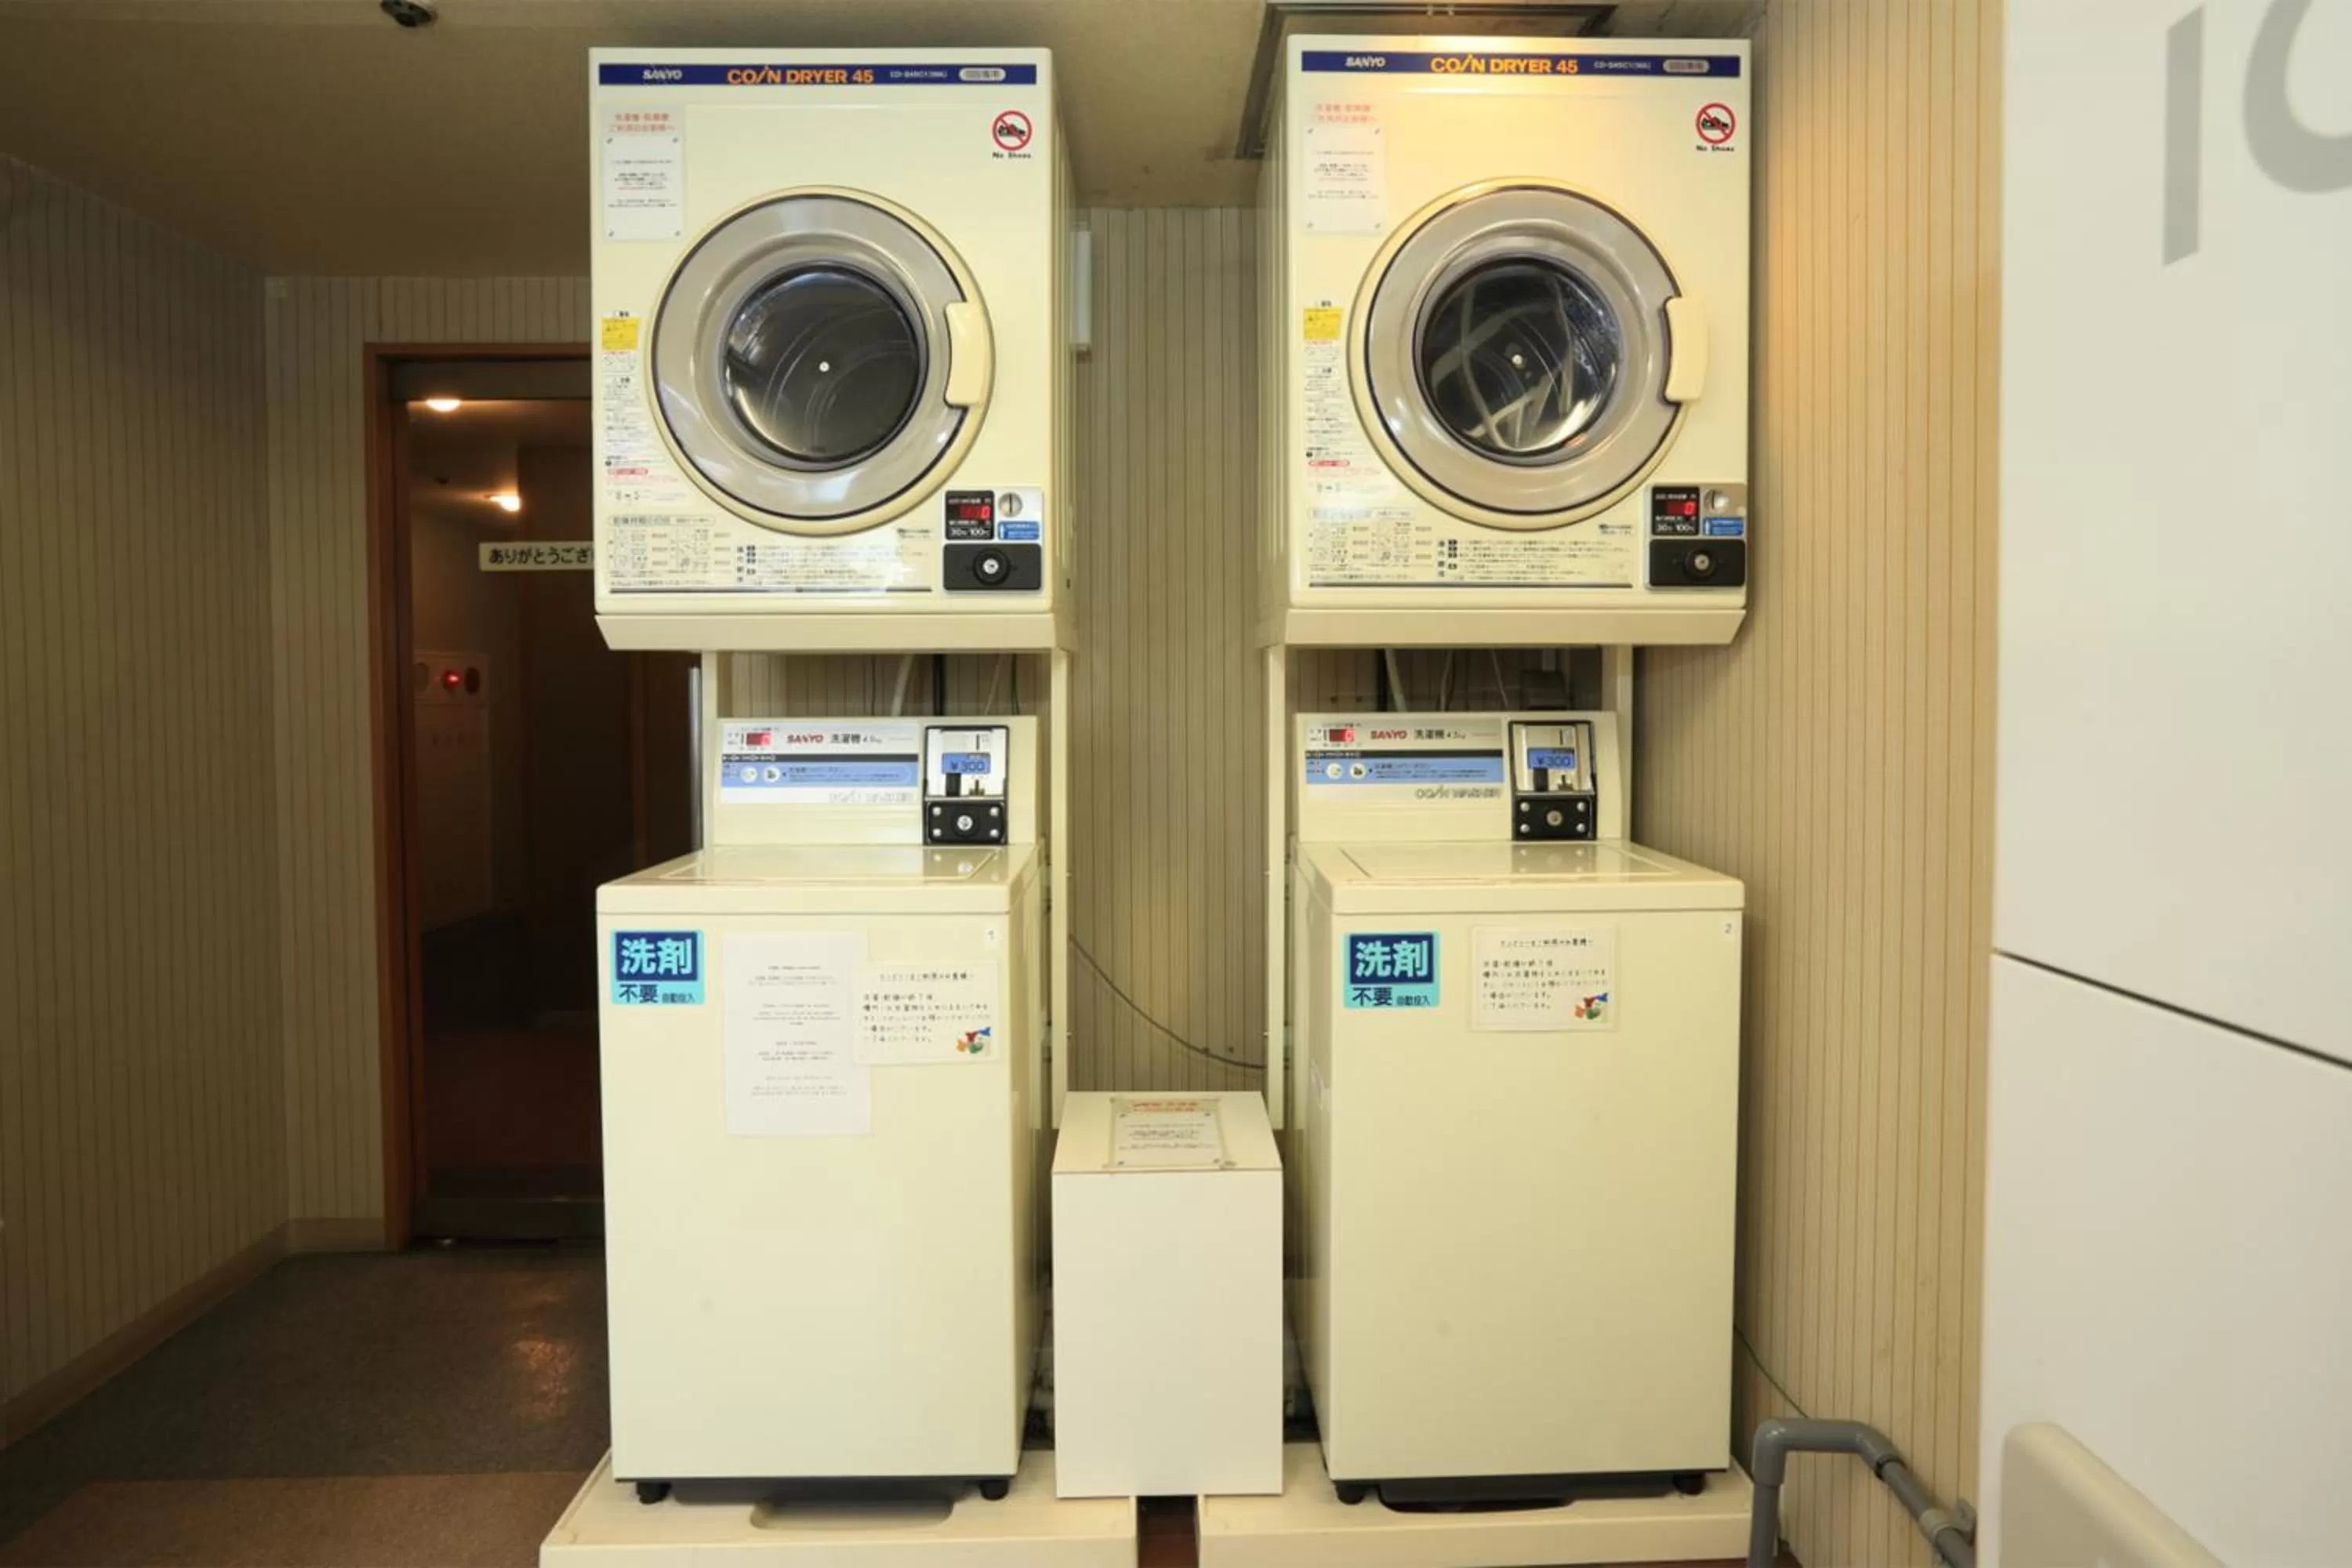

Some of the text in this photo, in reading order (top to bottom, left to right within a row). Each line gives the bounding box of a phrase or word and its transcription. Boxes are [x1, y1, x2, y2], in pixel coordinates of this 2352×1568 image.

[1346, 56, 1385, 68] SANYO
[1490, 57, 1552, 74] DRYER
[1556, 60, 1578, 74] 45
[642, 69, 683, 80] SANYO
[786, 69, 848, 84] DRYER
[852, 69, 874, 84] 45
[786, 734, 824, 744] SANYO
[1370, 730, 1408, 739] SANYO
[621, 937, 693, 975] 洗剤
[1354, 940, 1429, 978] 洗剤
[619, 984, 659, 1004] 不要
[1352, 987, 1431, 1007] 不要 自動投入
